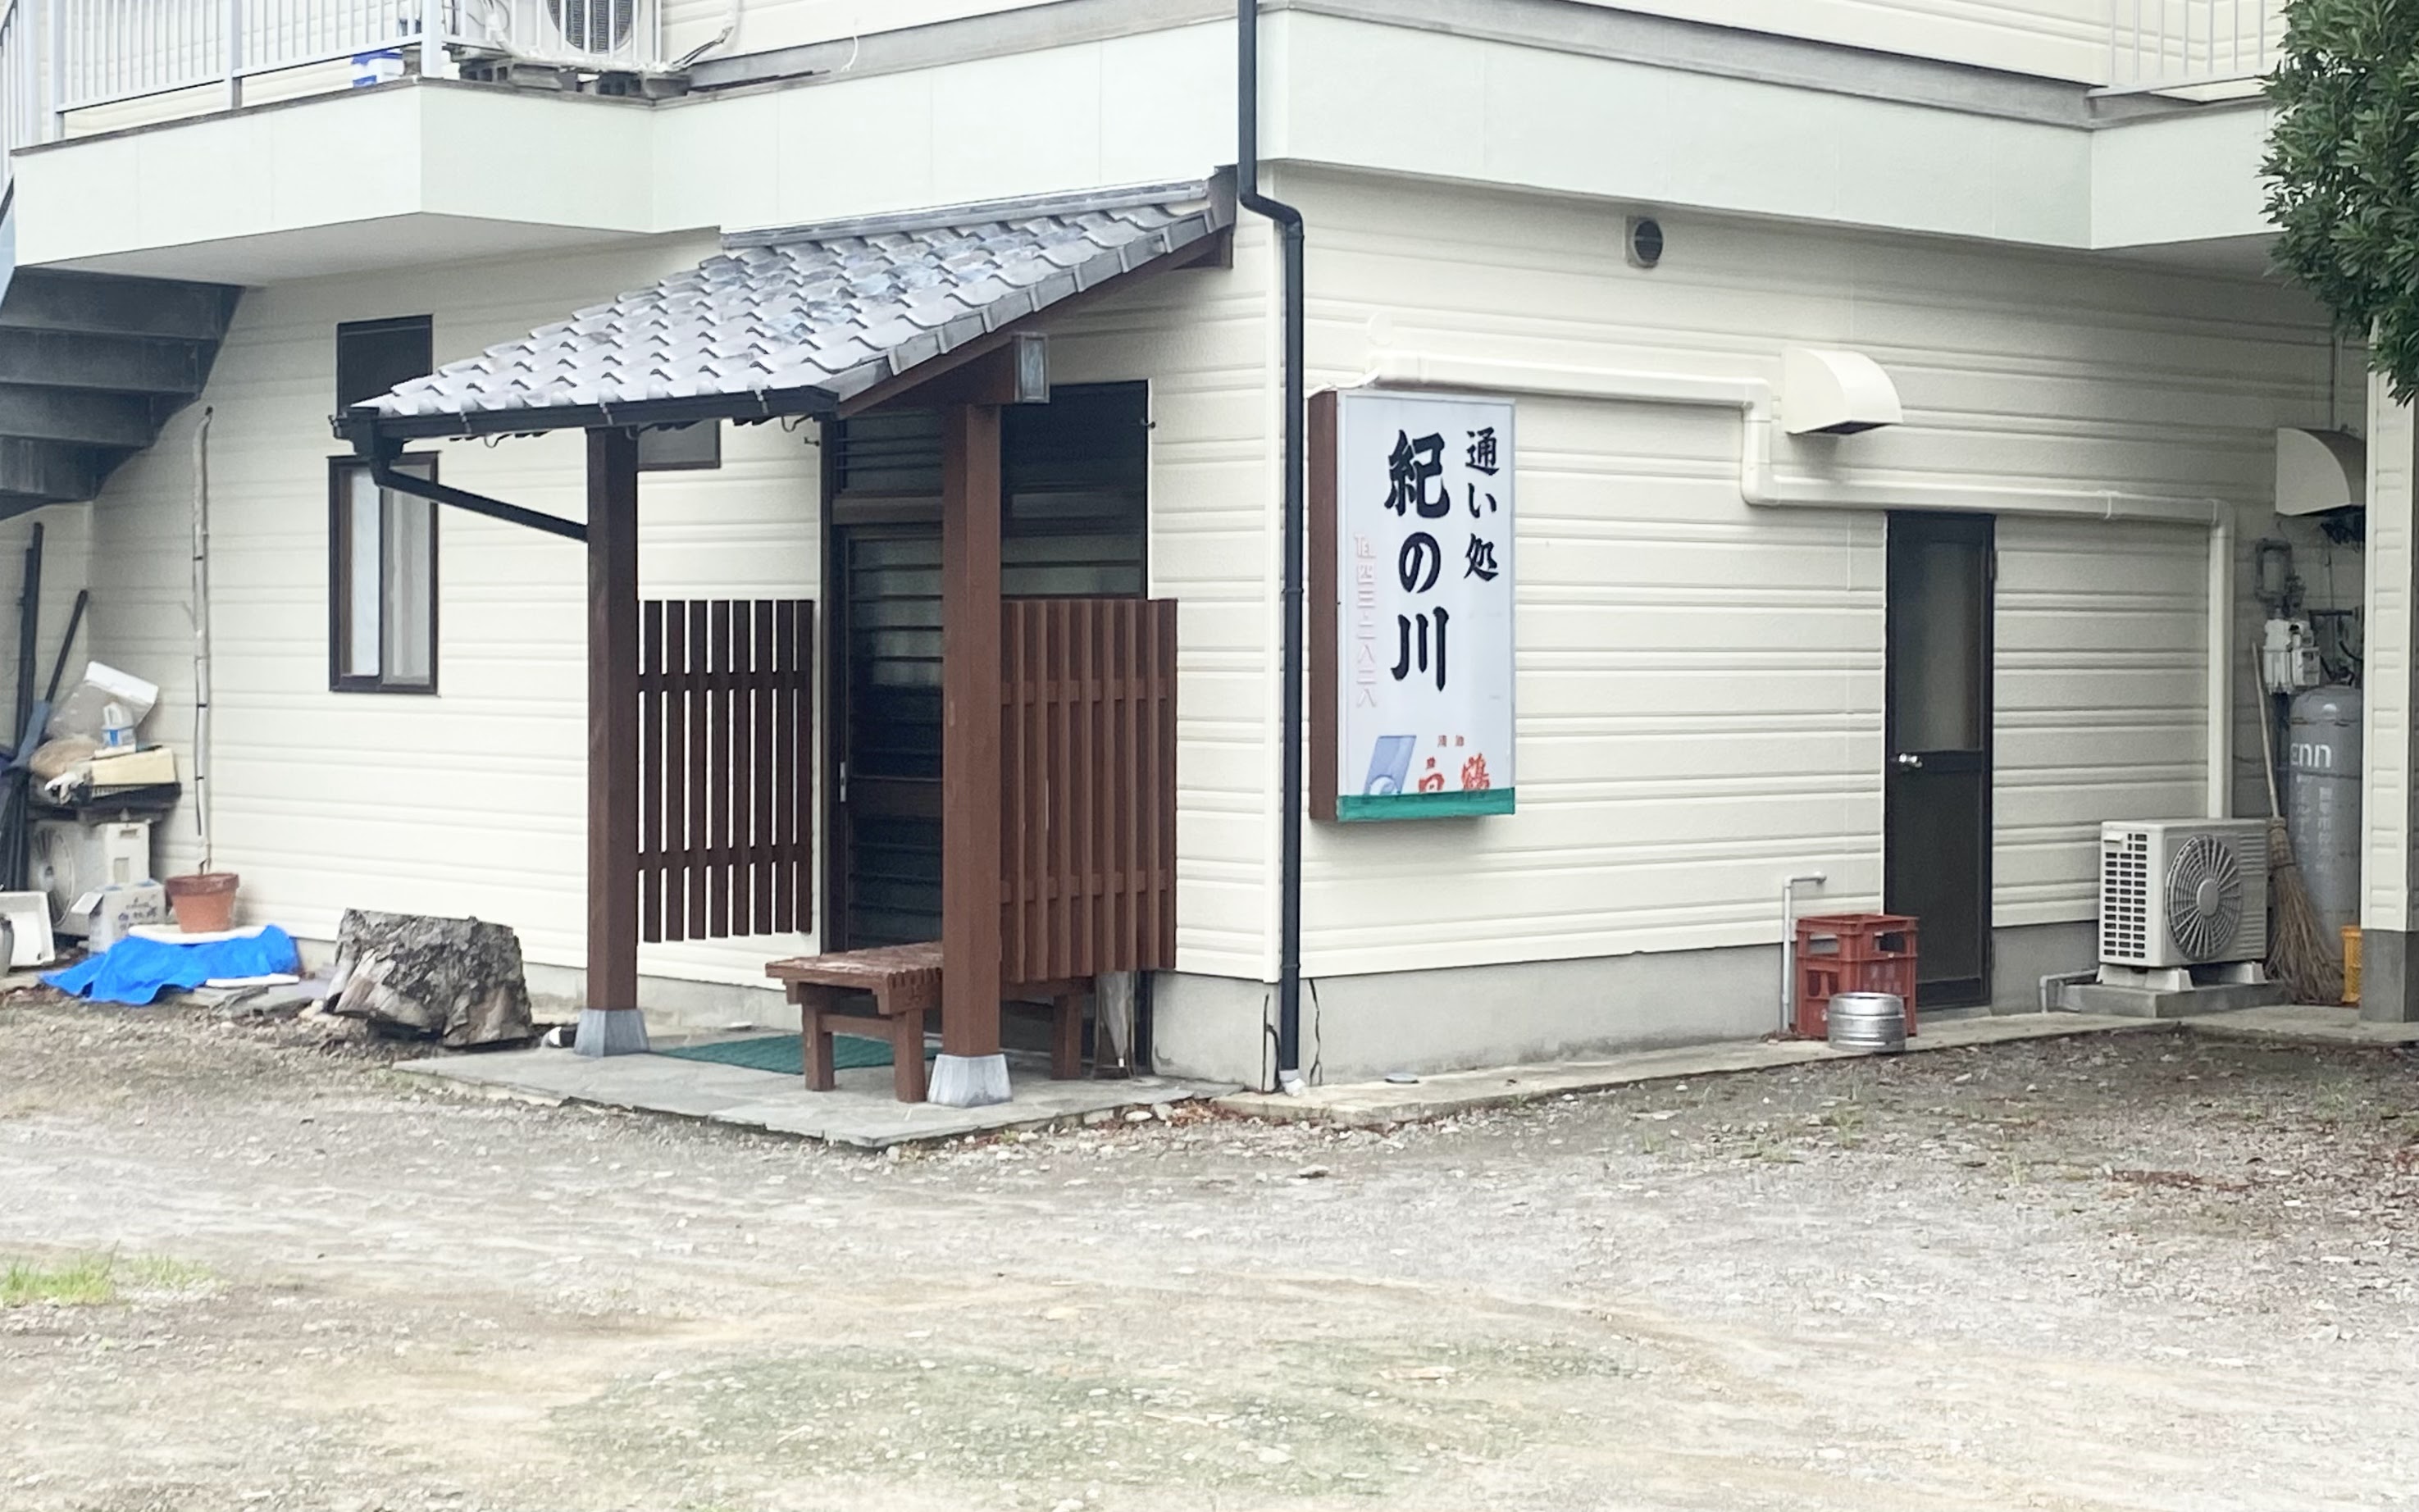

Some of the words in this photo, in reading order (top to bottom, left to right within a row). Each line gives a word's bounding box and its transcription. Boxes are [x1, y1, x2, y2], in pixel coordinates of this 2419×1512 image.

[1384, 429, 1450, 692] 紀の川
[1464, 426, 1500, 581] 通い処
